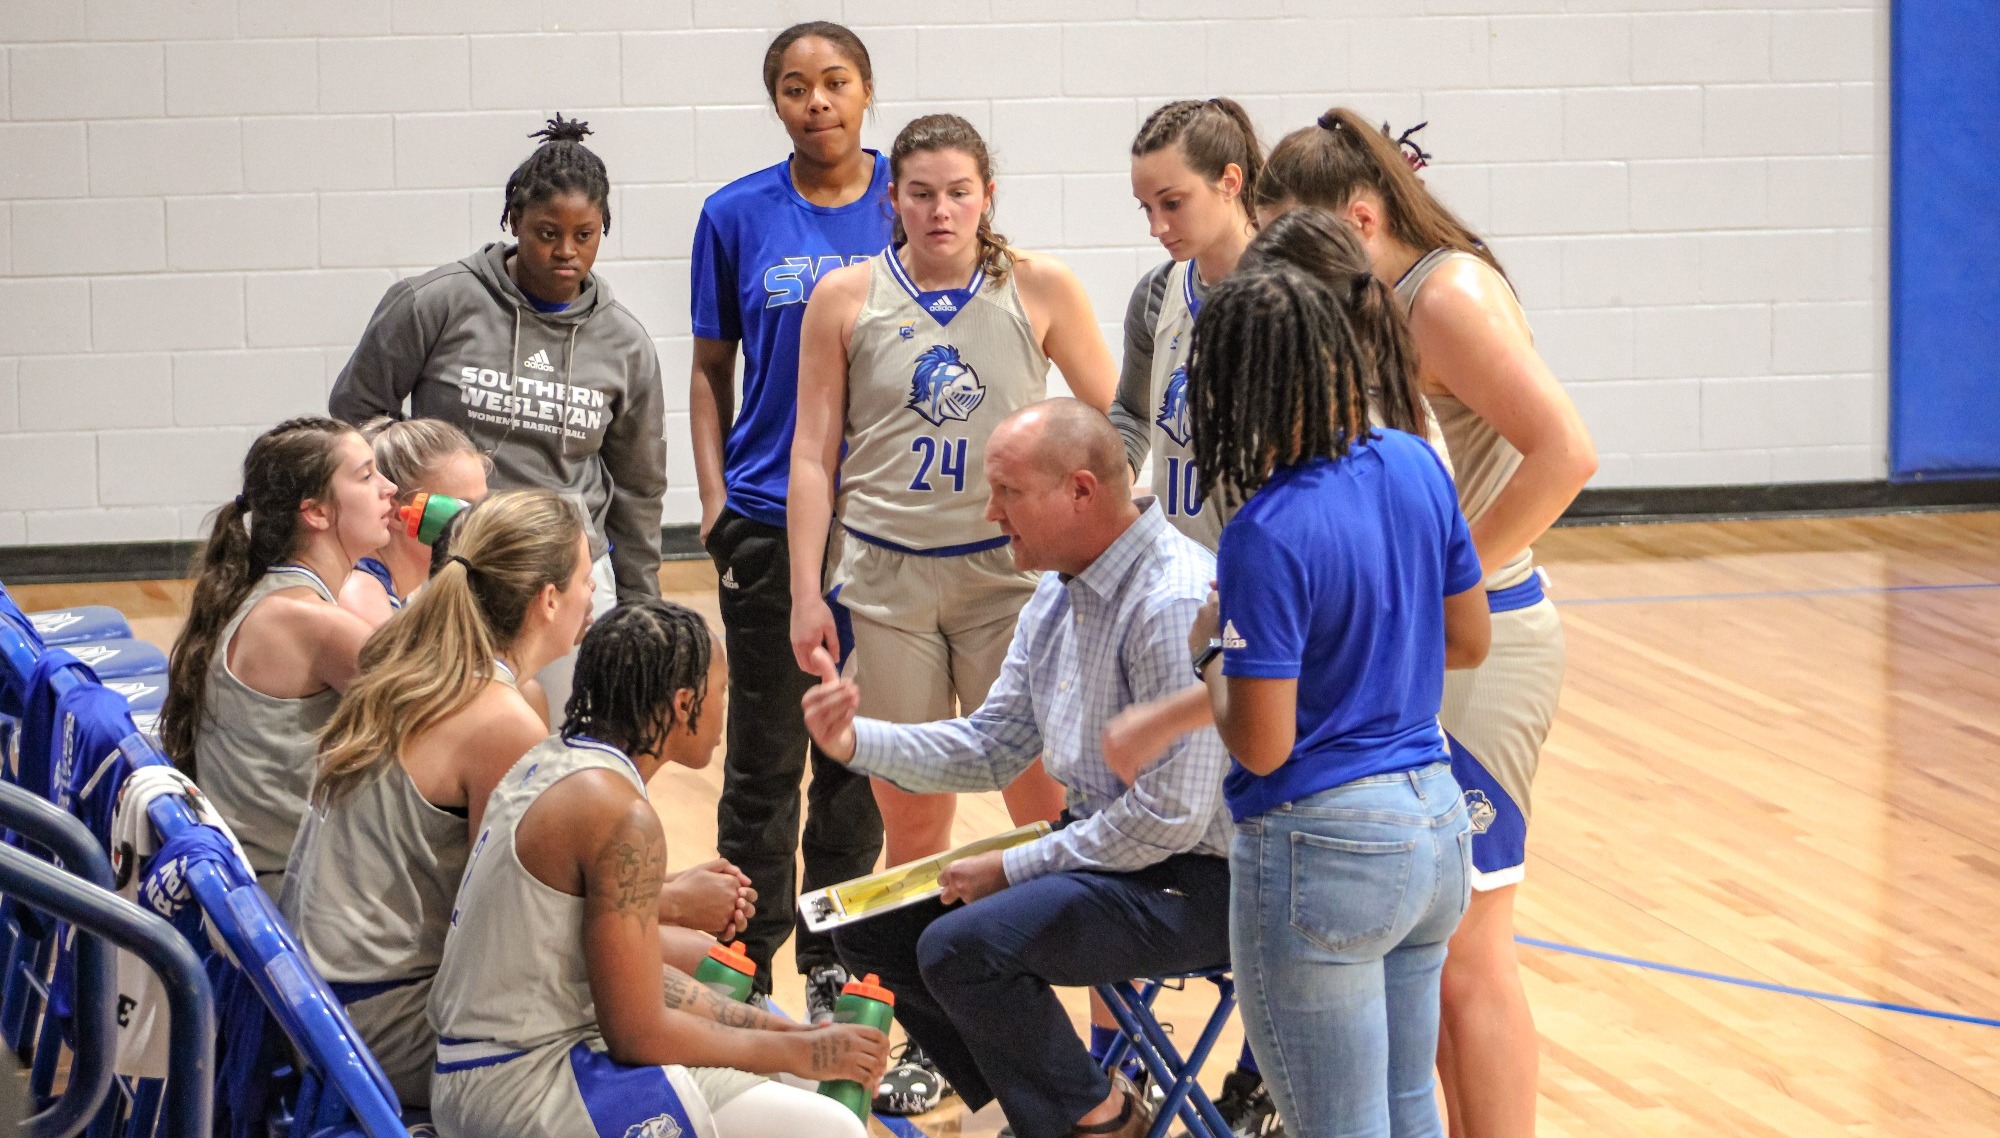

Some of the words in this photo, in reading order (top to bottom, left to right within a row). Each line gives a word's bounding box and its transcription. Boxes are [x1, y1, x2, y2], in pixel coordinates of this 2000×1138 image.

[461, 366, 604, 408] SOUTHERN
[524, 360, 554, 372] adidas
[461, 386, 601, 430] WESLEYAN
[468, 409, 520, 427] WOMEN'S
[523, 420, 586, 440] BASKETBALL
[908, 435, 967, 493] 24
[1167, 456, 1202, 517] 10
